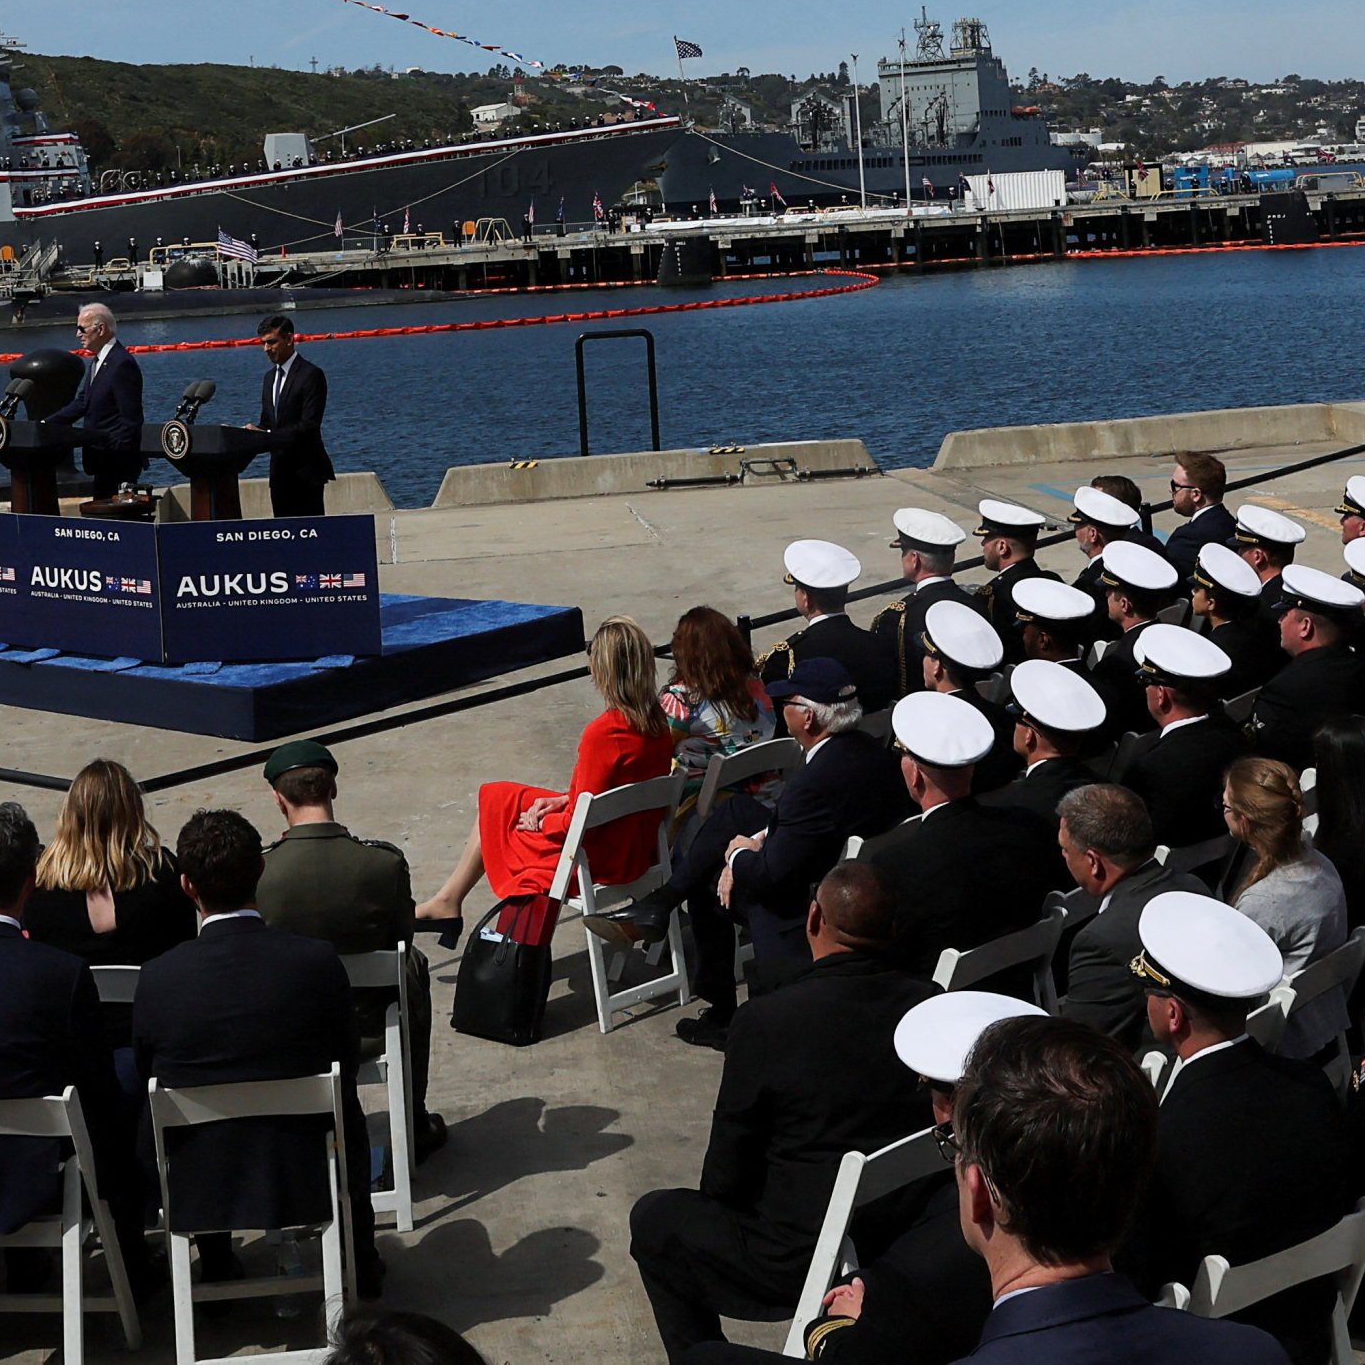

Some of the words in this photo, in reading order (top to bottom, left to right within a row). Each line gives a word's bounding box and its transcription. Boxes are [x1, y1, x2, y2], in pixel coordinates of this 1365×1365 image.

[55, 528, 72, 537] SAN
[75, 529, 105, 541] DIEGO,
[108, 532, 120, 541] CA
[216, 533, 243, 542] SAN
[249, 530, 295, 540] DIEGO,
[299, 529, 318, 538] CA
[30, 566, 102, 592] AUKUS
[176, 572, 289, 598] AUKUS
[0, 587, 17, 595] STATES
[84, 596, 108, 604] KINGDOM
[176, 601, 221, 609] AUSTRALIA
